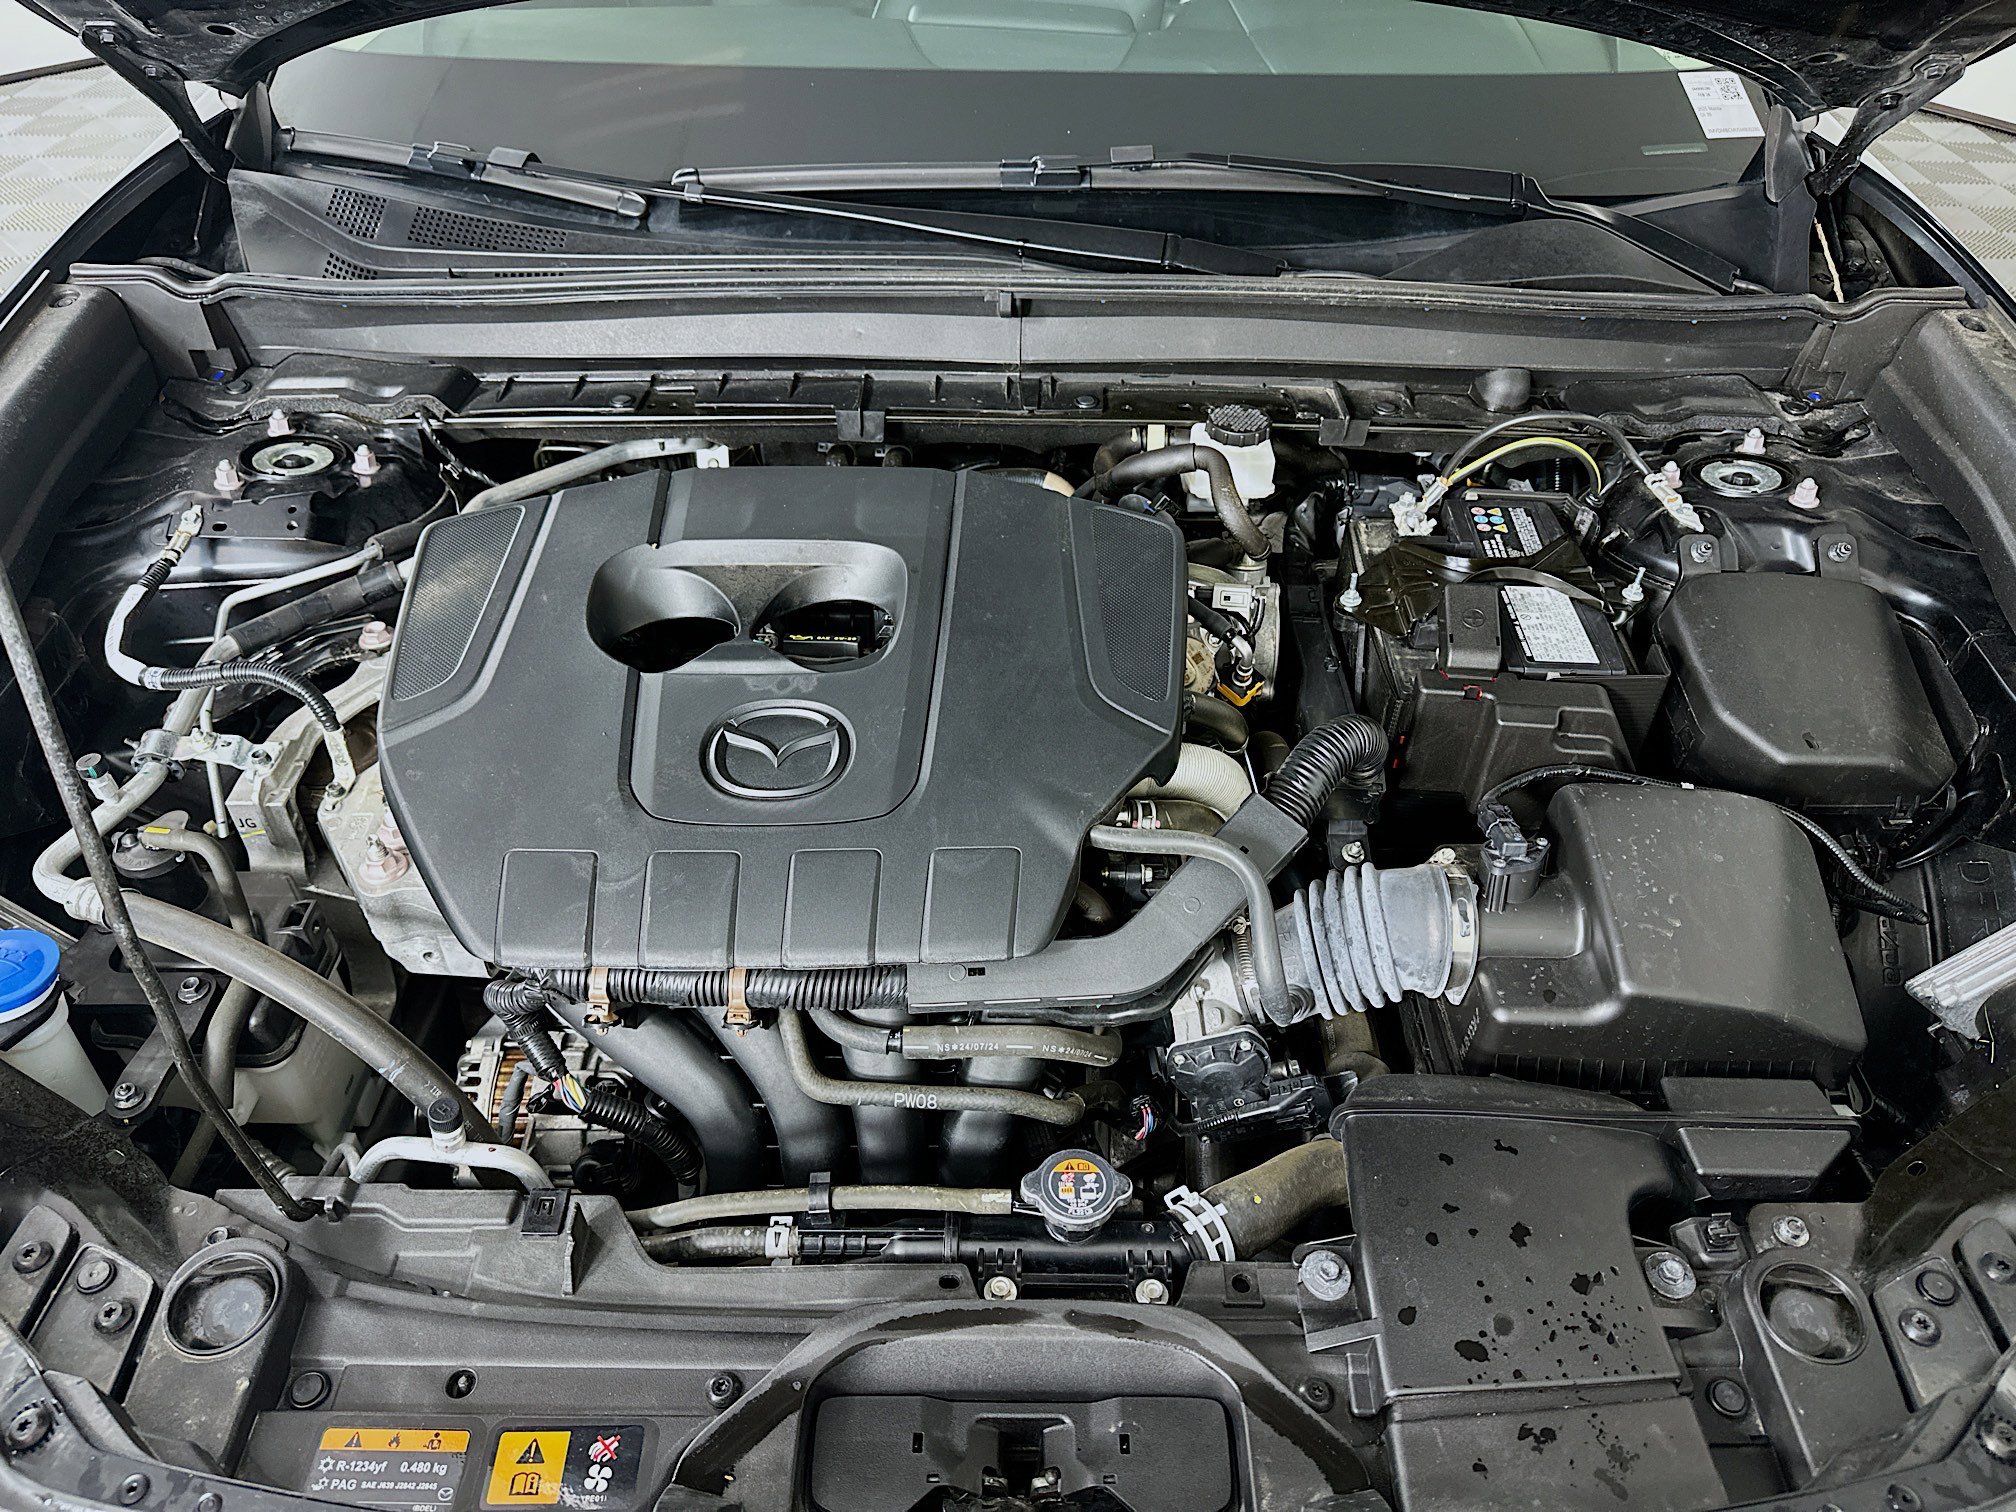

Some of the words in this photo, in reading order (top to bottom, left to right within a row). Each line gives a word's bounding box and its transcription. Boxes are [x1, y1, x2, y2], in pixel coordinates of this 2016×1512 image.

[893, 1092, 938, 1110] PW08
[335, 1460, 388, 1474] R-1234yf
[400, 1461, 431, 1473] 0.480
[432, 1461, 448, 1476] kg
[330, 1478, 357, 1490] PAG
